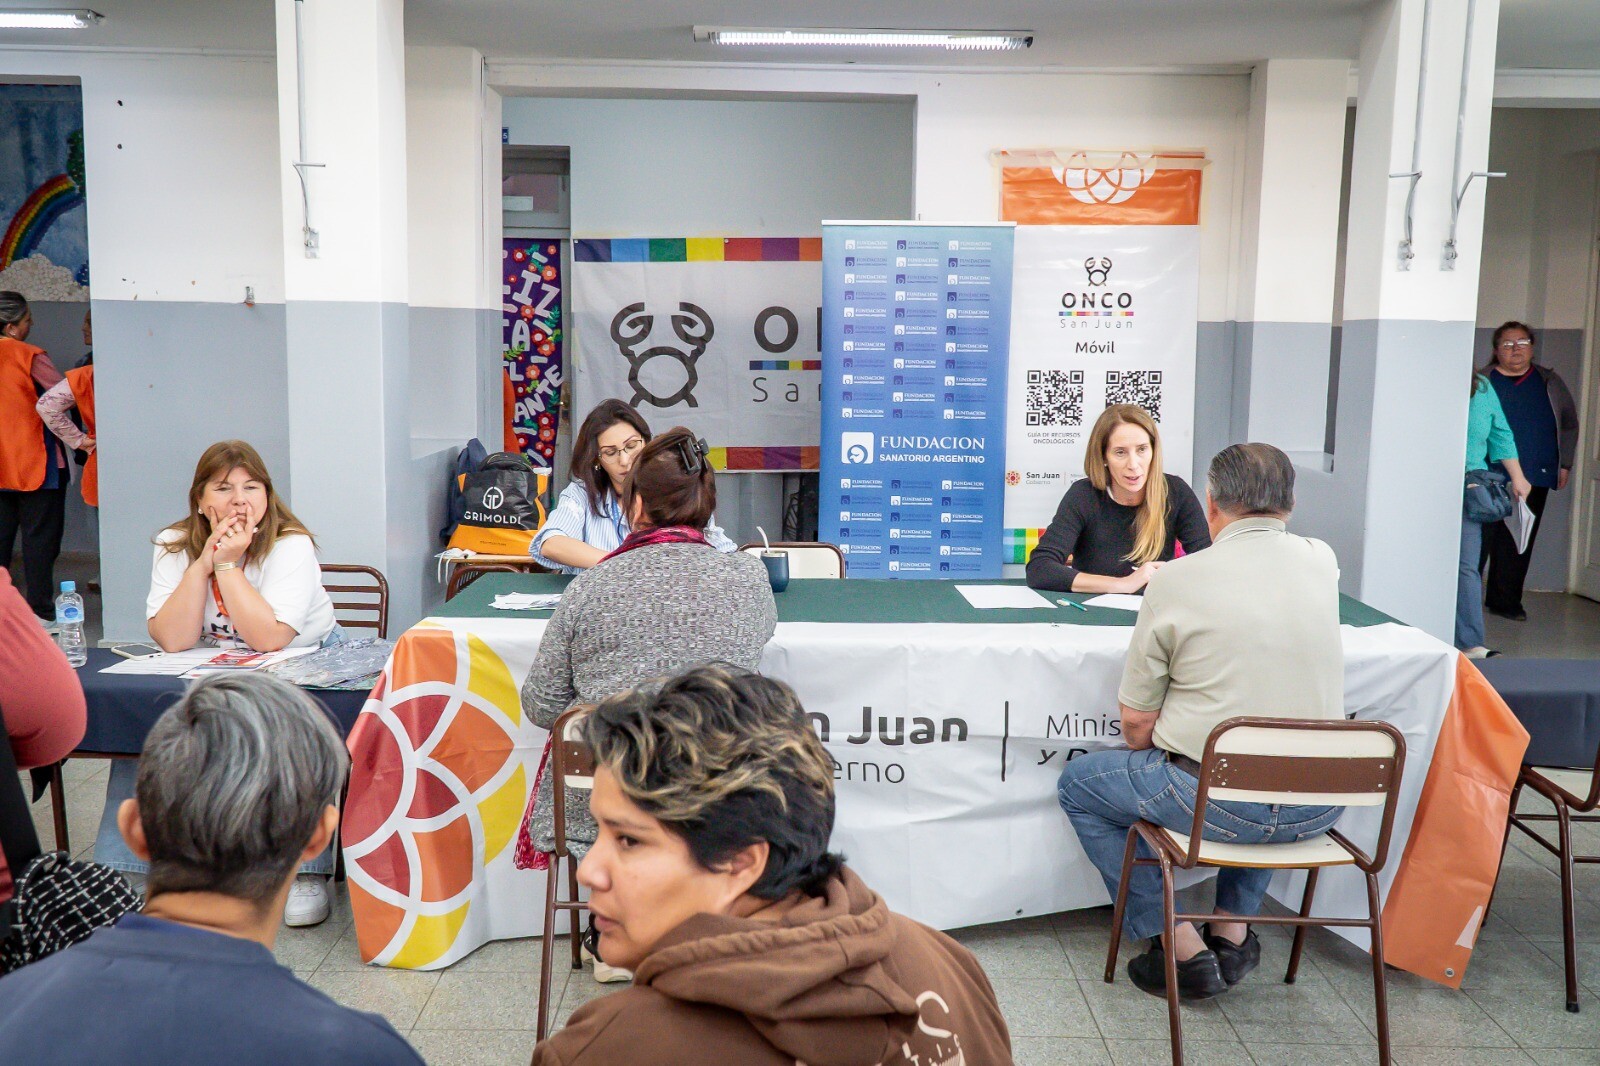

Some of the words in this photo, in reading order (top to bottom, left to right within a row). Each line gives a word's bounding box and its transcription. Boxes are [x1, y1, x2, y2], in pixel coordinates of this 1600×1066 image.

[1061, 293, 1132, 308] ONCO
[1060, 318, 1087, 328] San
[1095, 319, 1133, 329] Juan
[1075, 340, 1115, 354] Móvil
[753, 377, 821, 402] Sa
[880, 436, 985, 450] FUNDACION
[879, 454, 931, 463] SANATORIO
[932, 455, 985, 464] ARGENTINO
[846, 706, 968, 746] Juan
[1046, 713, 1121, 739] Minis
[1037, 749, 1058, 765] y
[833, 761, 905, 784] erno
